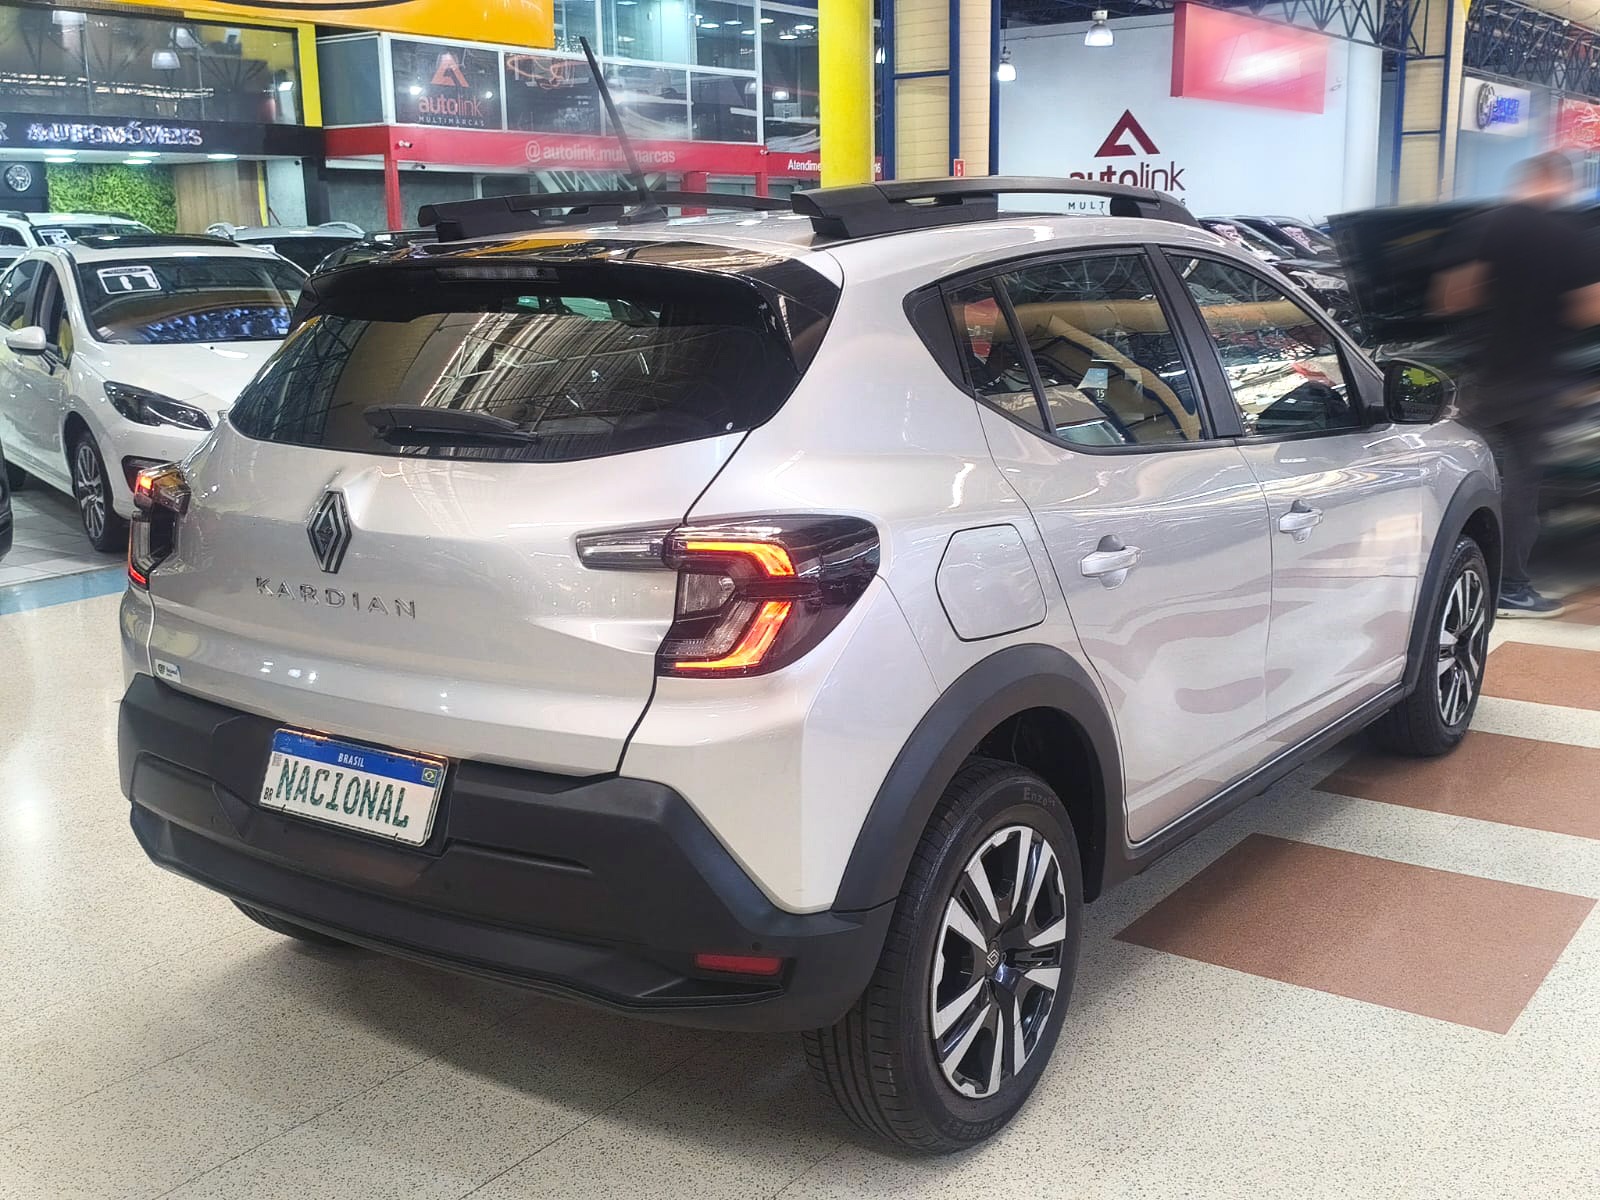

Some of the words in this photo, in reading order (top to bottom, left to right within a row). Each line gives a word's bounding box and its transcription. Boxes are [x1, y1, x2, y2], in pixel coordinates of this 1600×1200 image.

[418, 93, 483, 117] autolink
[525, 140, 676, 164] @autolink.mulmarcas
[255, 576, 416, 619] KARDIAN
[337, 752, 365, 768] BRASIL
[263, 786, 274, 801] BR
[275, 758, 409, 829] NACIONAL
